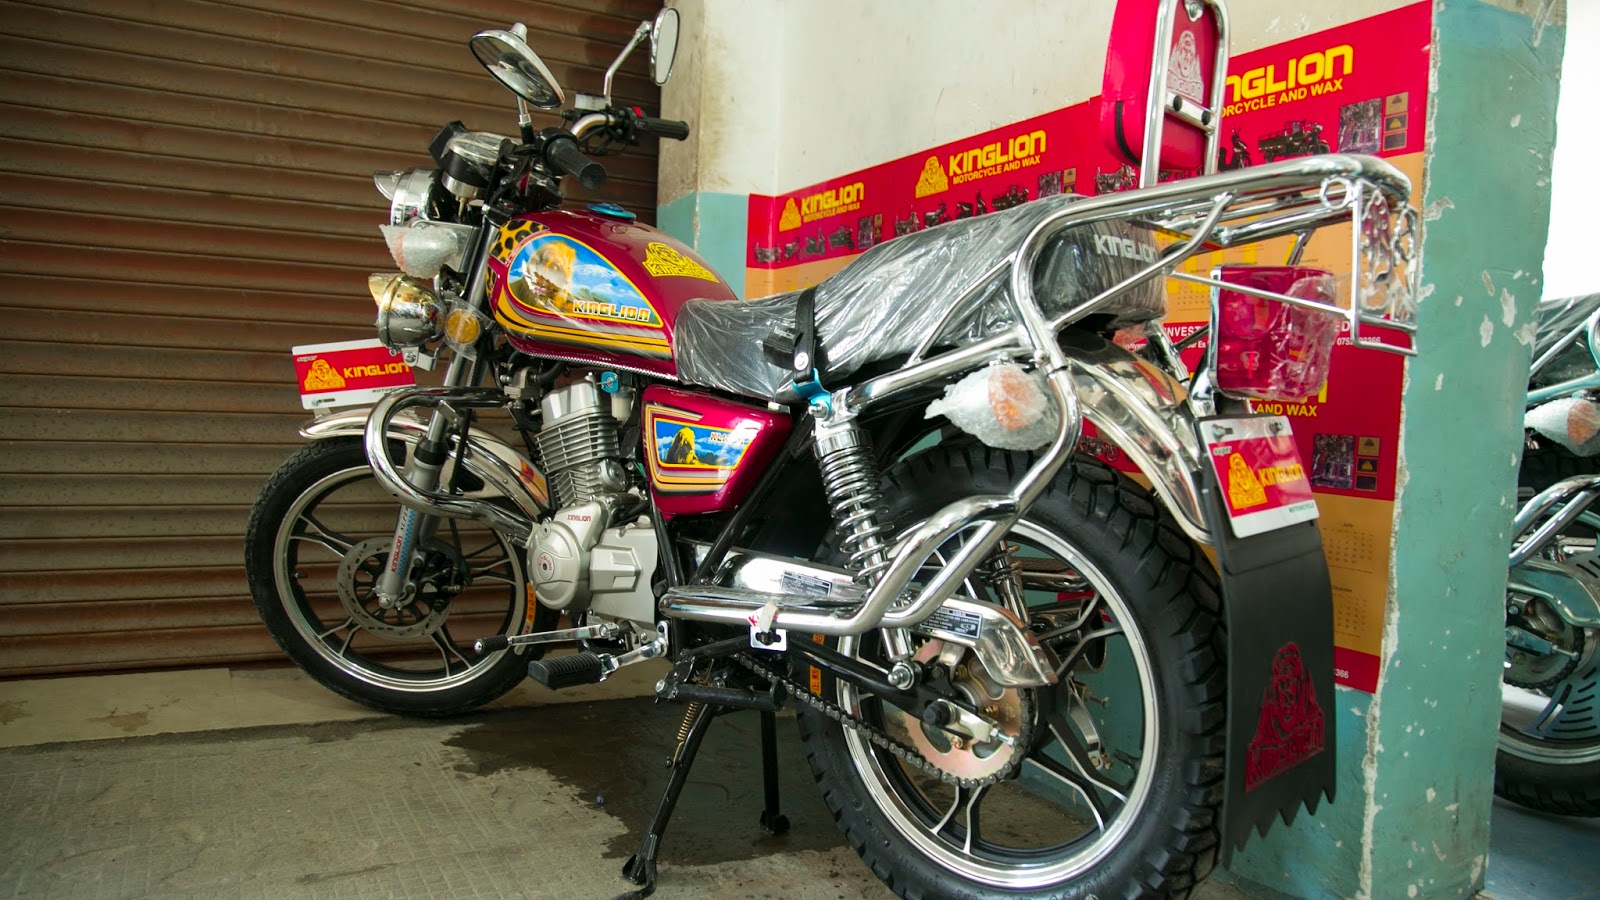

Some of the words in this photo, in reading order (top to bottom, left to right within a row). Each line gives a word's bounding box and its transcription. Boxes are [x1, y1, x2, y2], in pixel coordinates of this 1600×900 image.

[1226, 44, 1354, 102] NGLION
[1222, 95, 1276, 118] ORCYCLE
[1279, 87, 1308, 104] AND
[1310, 78, 1343, 96] WAX
[948, 130, 1047, 177] KINGLION
[952, 165, 1003, 185] MOTORCYCLE
[1003, 160, 1021, 172] AND
[1021, 155, 1042, 168] WAX
[801, 182, 865, 216] KINGLION
[572, 300, 651, 322] KINGLION
[343, 361, 410, 378] KINGLION
[1256, 403, 1283, 415] AND
[1286, 404, 1318, 417] WAX
[1213, 446, 1232, 456] super
[1289, 502, 1315, 513] MOTORCYCLE
